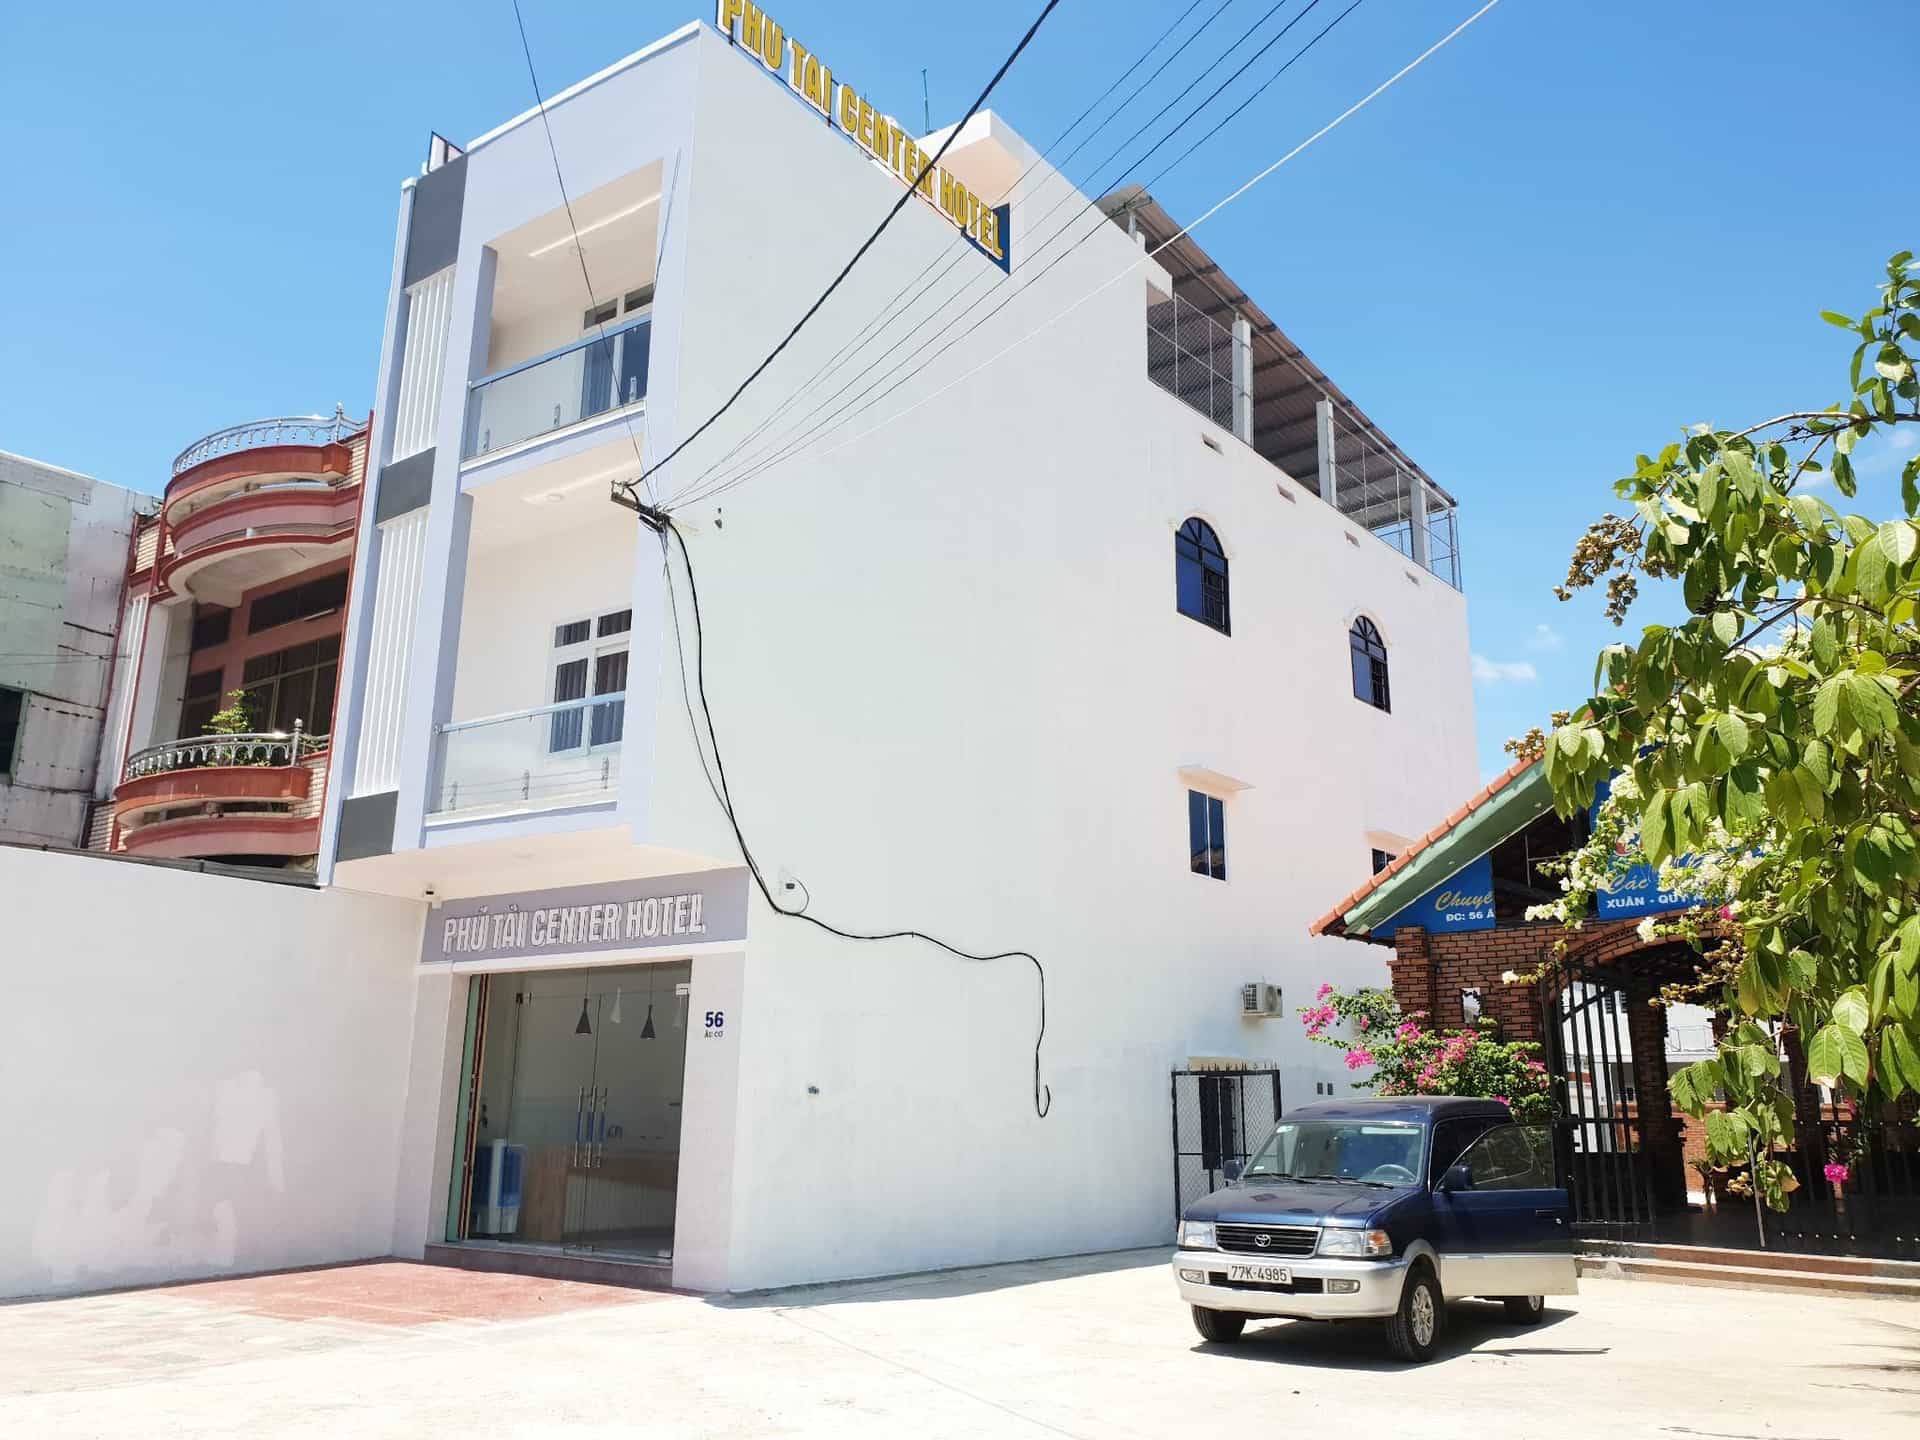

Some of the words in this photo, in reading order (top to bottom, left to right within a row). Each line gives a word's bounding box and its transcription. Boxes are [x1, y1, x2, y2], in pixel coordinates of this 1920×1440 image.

[718, 0, 784, 71] PHU
[788, 37, 832, 116] TAI
[837, 83, 934, 203] CENTER
[937, 165, 1004, 261] HOTEL
[531, 902, 621, 947] CENTER
[625, 894, 705, 939] HOTEL
[1468, 911, 1484, 920] 56
[705, 1011, 724, 1028] 56
